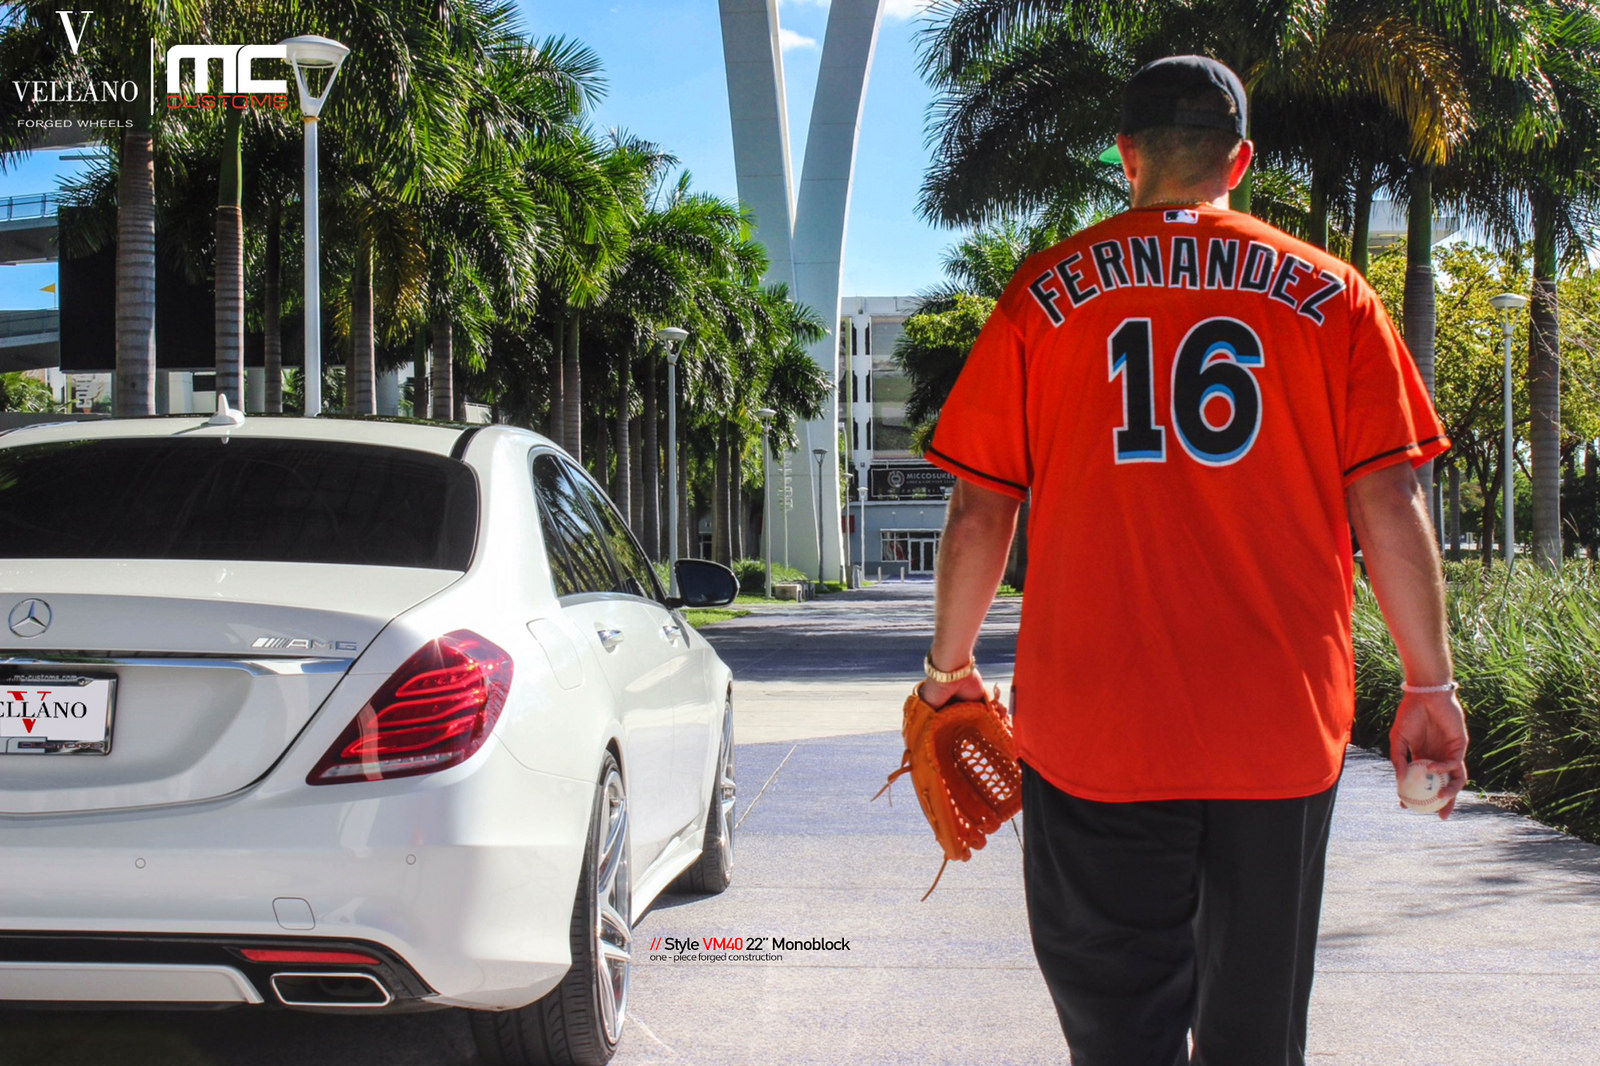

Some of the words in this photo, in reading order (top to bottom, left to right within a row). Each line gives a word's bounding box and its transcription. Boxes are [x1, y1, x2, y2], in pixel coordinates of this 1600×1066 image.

[1028, 236, 1347, 328] FERNANDEZ
[1107, 316, 1265, 467] 16
[286, 639, 357, 651] AMG
